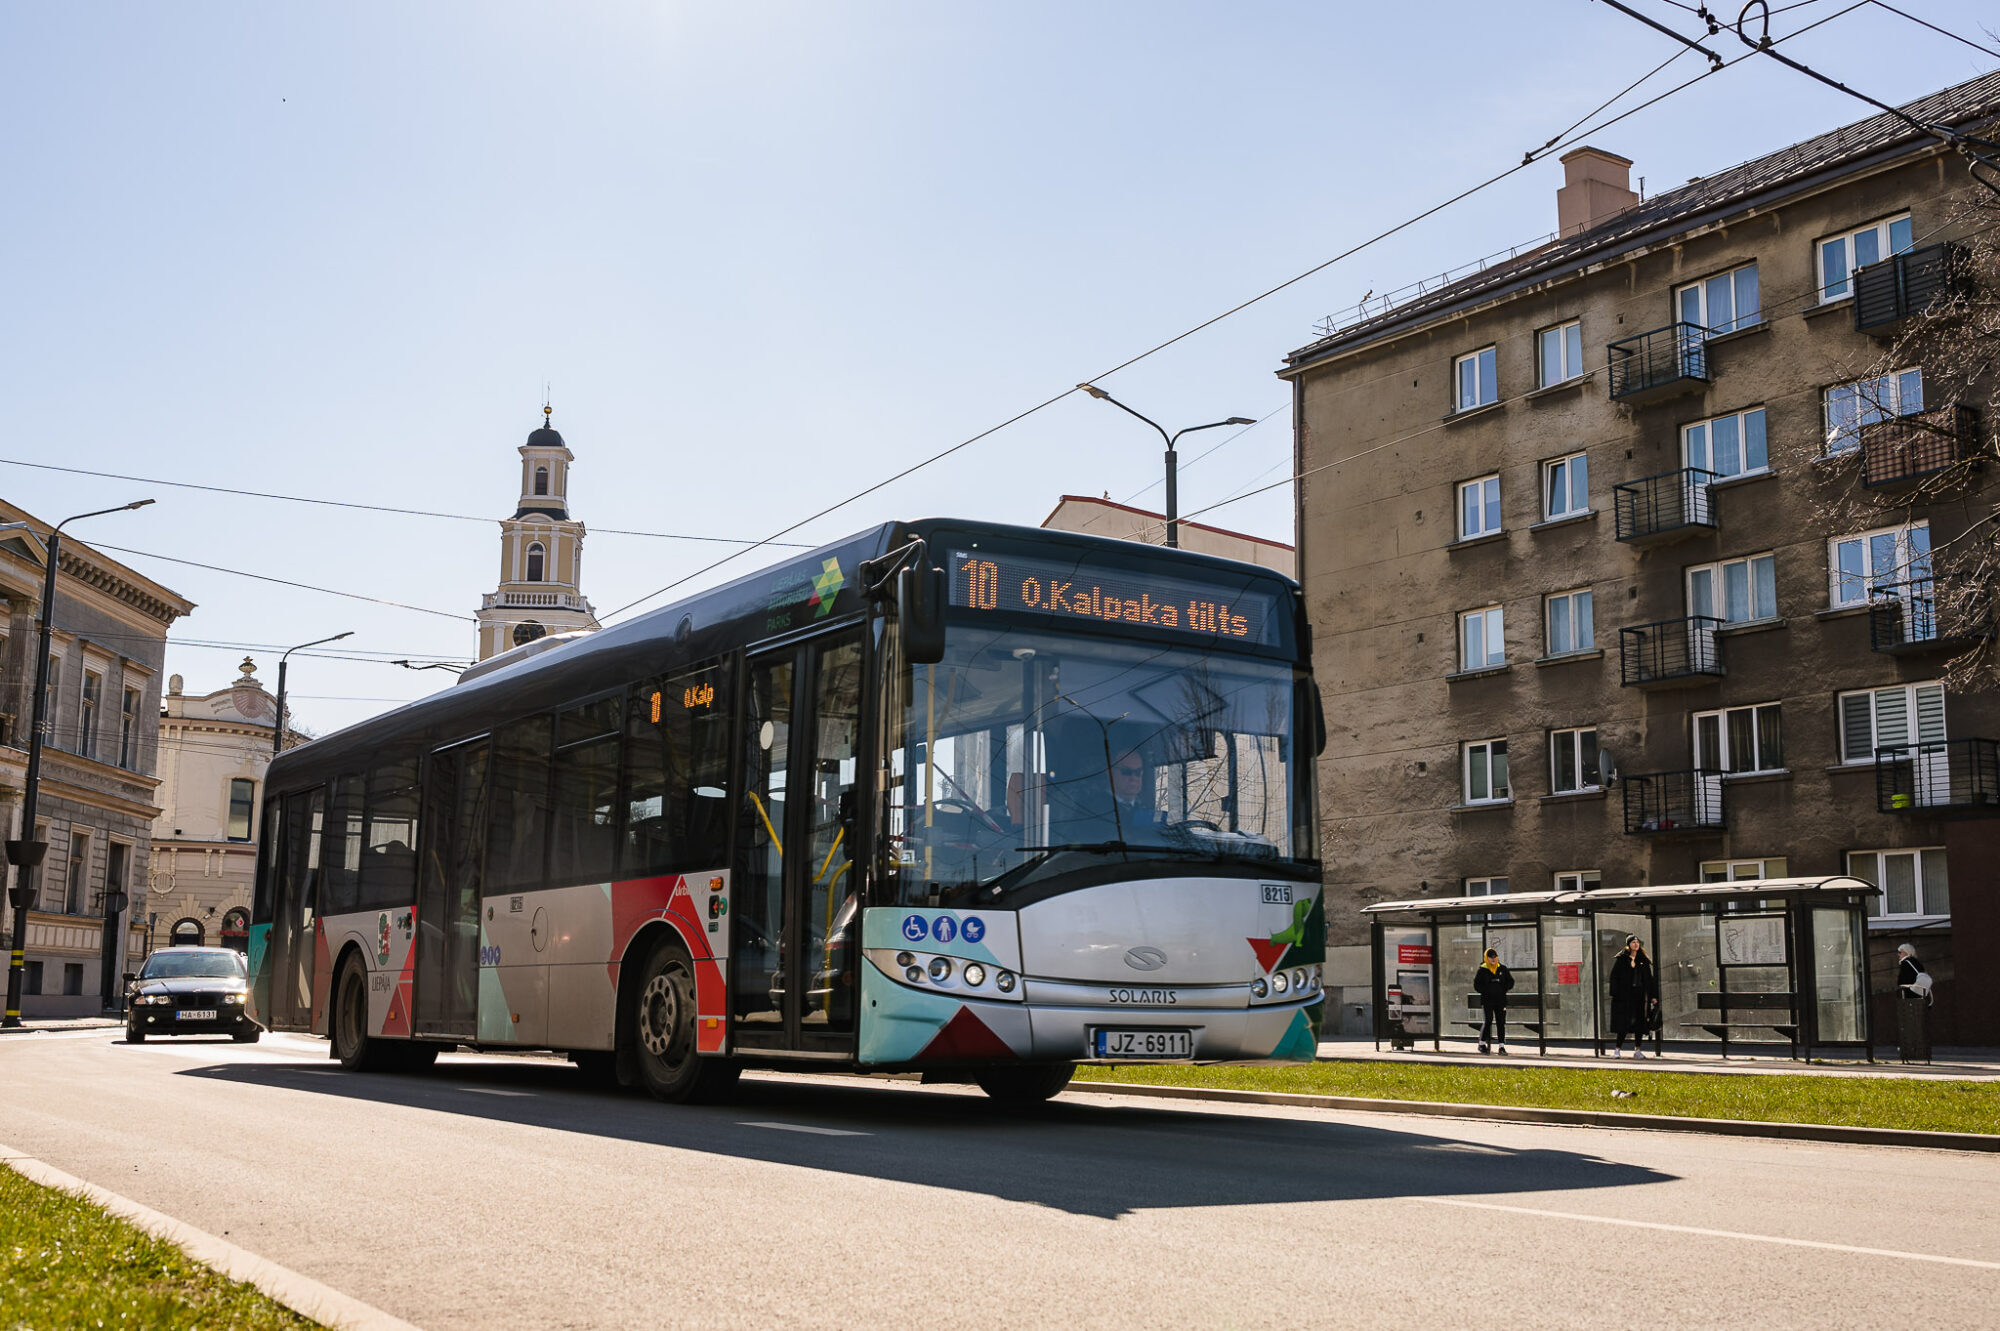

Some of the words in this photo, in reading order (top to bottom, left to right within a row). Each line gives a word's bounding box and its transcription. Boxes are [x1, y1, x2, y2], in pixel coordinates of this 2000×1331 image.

[961, 560, 998, 610] 10
[1022, 577, 1178, 627] O.Kalpaka
[1187, 600, 1248, 636] tilts
[1264, 887, 1290, 902] 8215
[1109, 989, 1177, 1004] SOLARIS
[1111, 1034, 1186, 1053] JZ-6911
